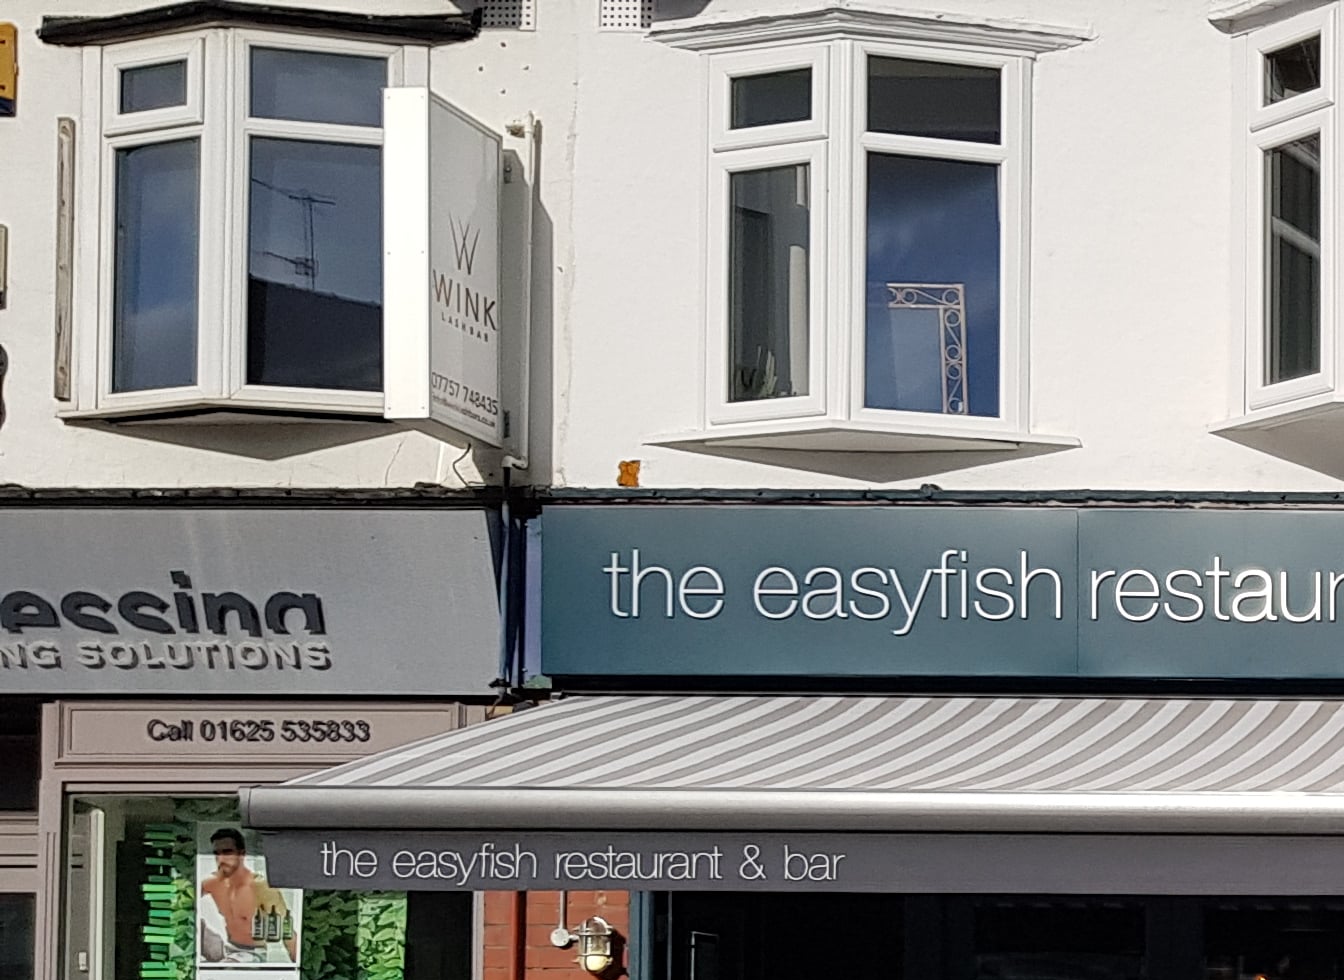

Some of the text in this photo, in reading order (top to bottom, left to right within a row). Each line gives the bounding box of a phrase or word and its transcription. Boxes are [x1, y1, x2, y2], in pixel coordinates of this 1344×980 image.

[433, 269, 497, 330] WINK
[432, 372, 460, 398] 07757
[603, 549, 725, 619] the
[753, 550, 1063, 635] easyfish
[76, 639, 333, 671] SOLUTIONS
[147, 719, 371, 742] Call 01625 535833
[320, 841, 846, 886] the easyfish restaurant & bar
